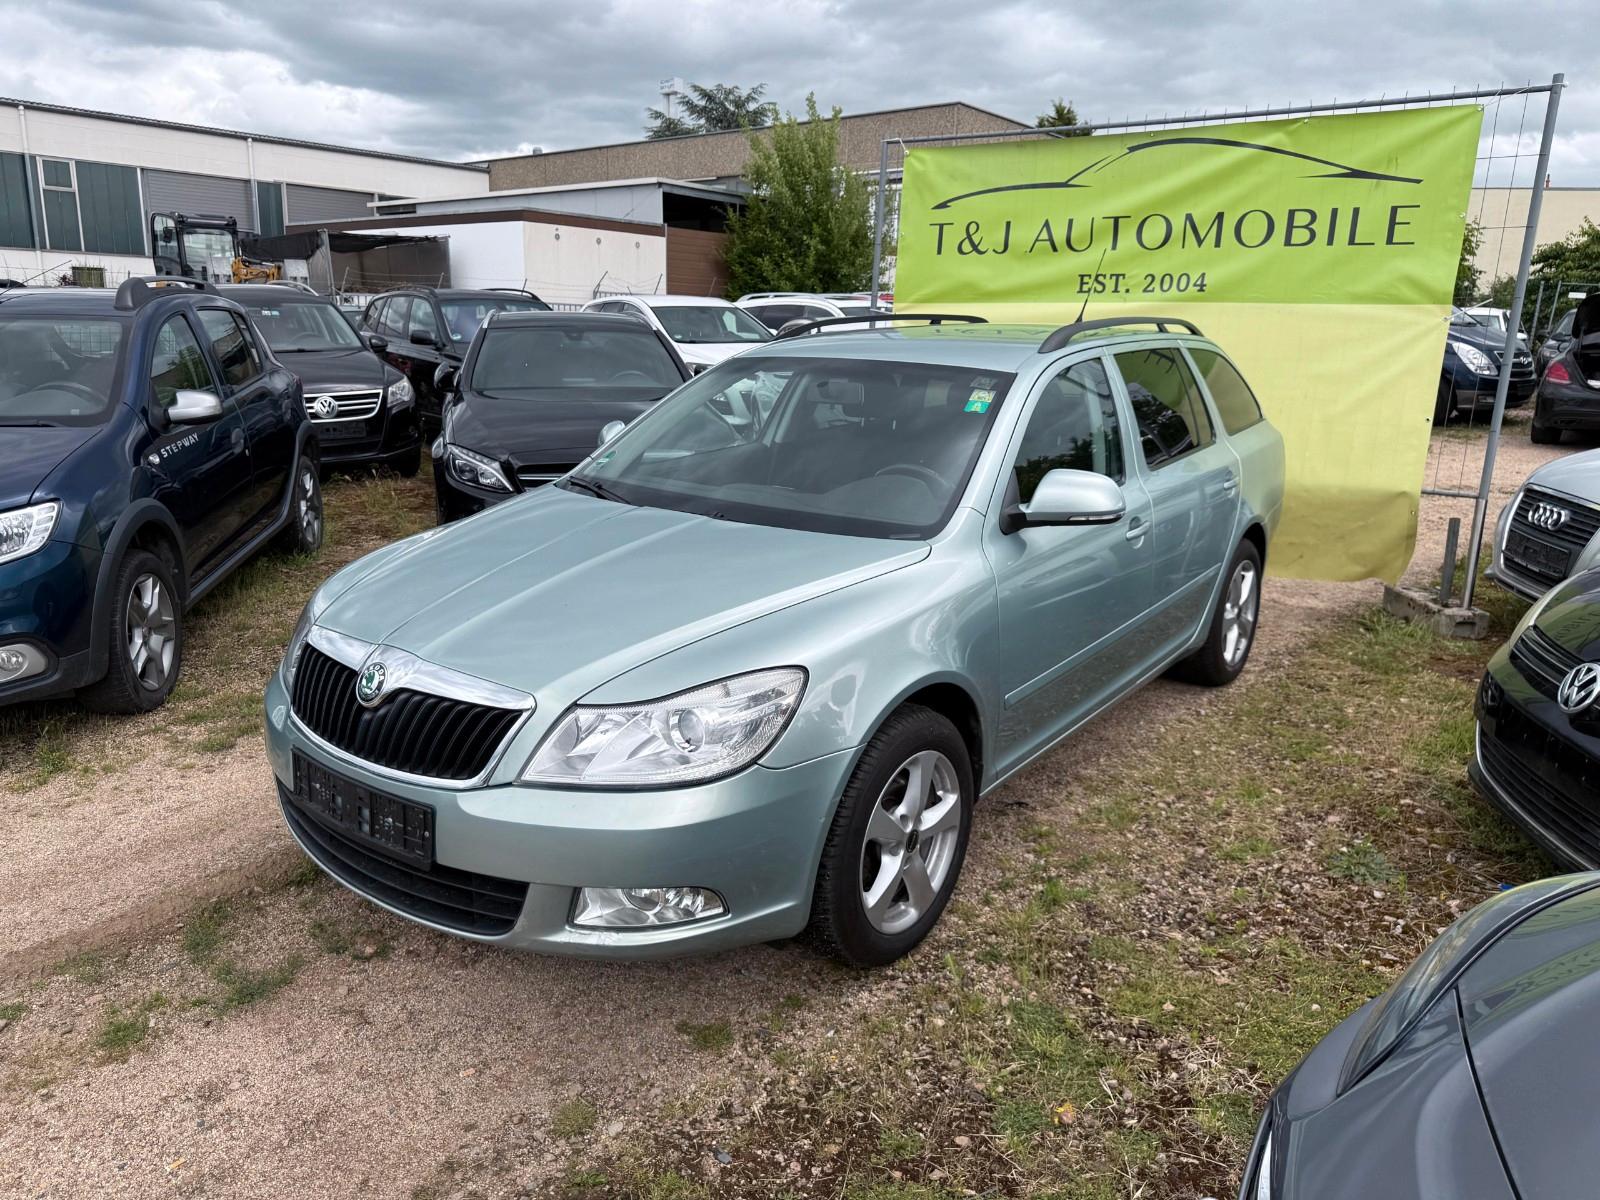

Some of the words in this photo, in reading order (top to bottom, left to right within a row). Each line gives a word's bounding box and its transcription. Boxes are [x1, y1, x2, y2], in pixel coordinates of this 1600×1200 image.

[929, 220, 1012, 256] T&J
[1028, 204, 1421, 254] AUTOMOBILE
[1076, 272, 1130, 294] EST.
[1142, 272, 1208, 294] 2004
[160, 432, 199, 458] STEPWAY
[1559, 663, 1600, 711] VW
